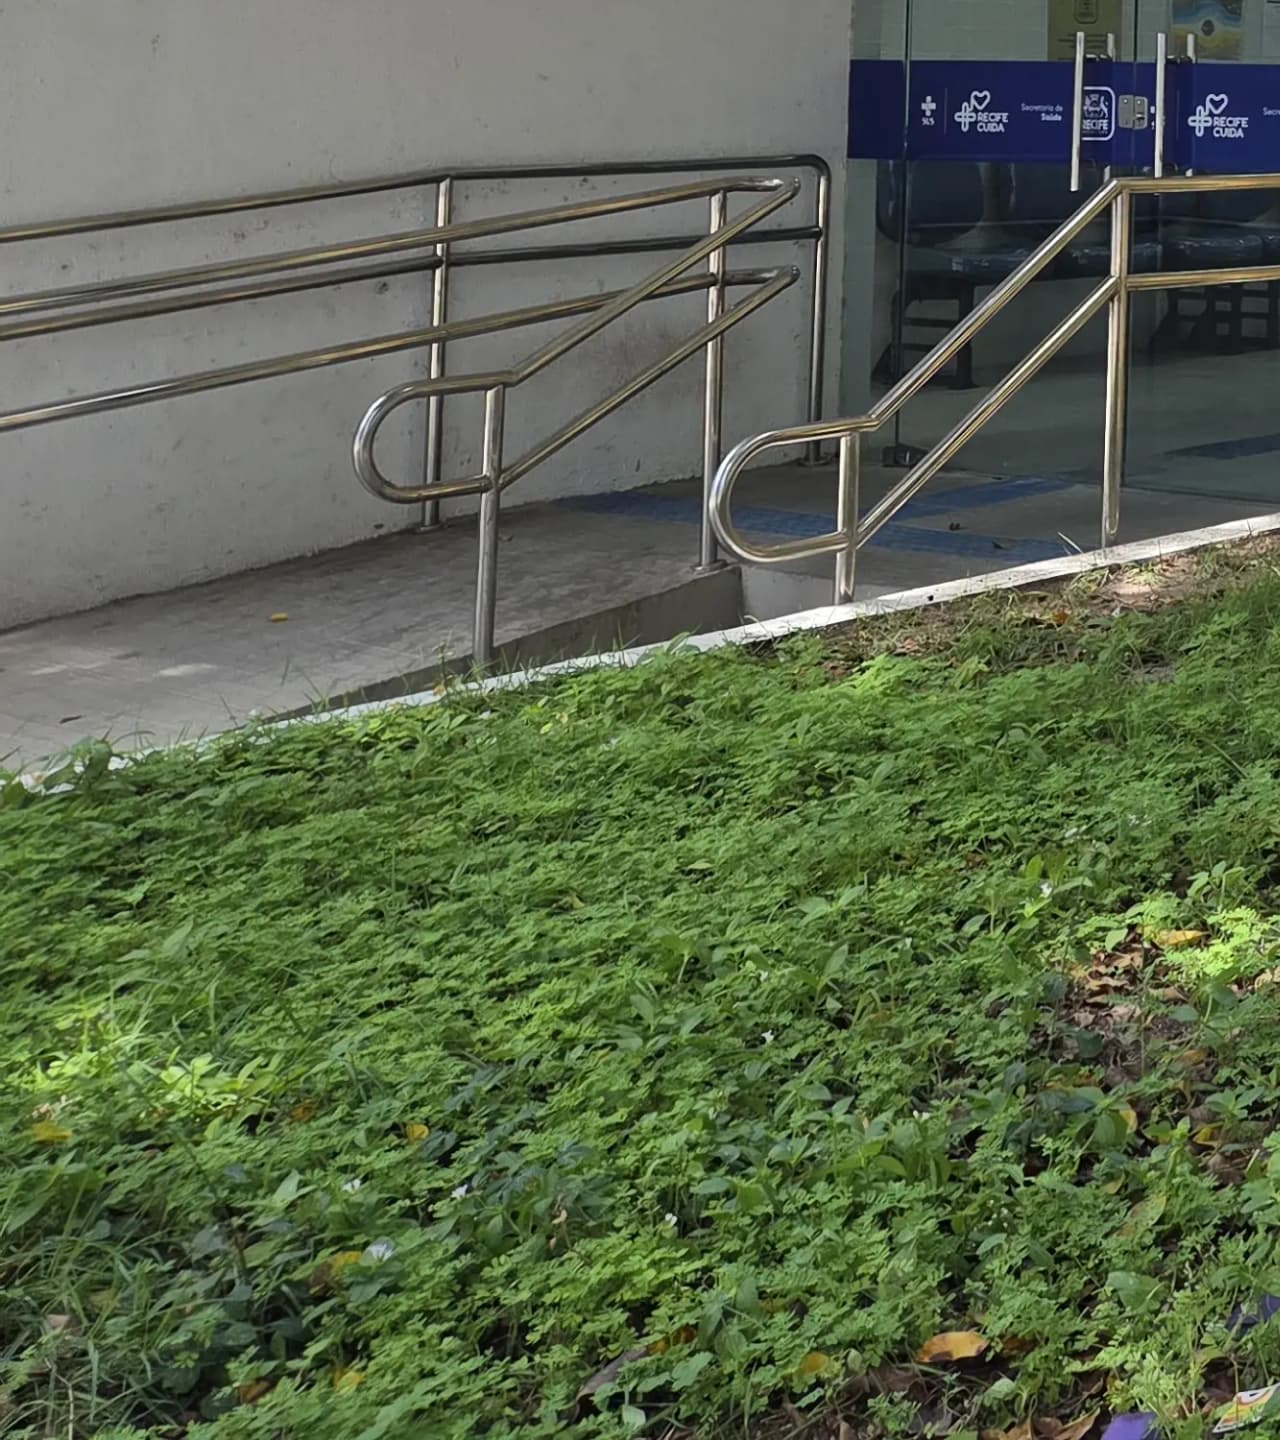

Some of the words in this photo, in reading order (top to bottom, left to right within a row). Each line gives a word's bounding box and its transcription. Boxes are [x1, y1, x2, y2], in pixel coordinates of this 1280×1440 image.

[977, 112, 1009, 123] RECIFE
[1213, 116, 1249, 128] RECIFE
[977, 122, 1005, 133] CUIDA
[1213, 127, 1244, 138] CUIDA
